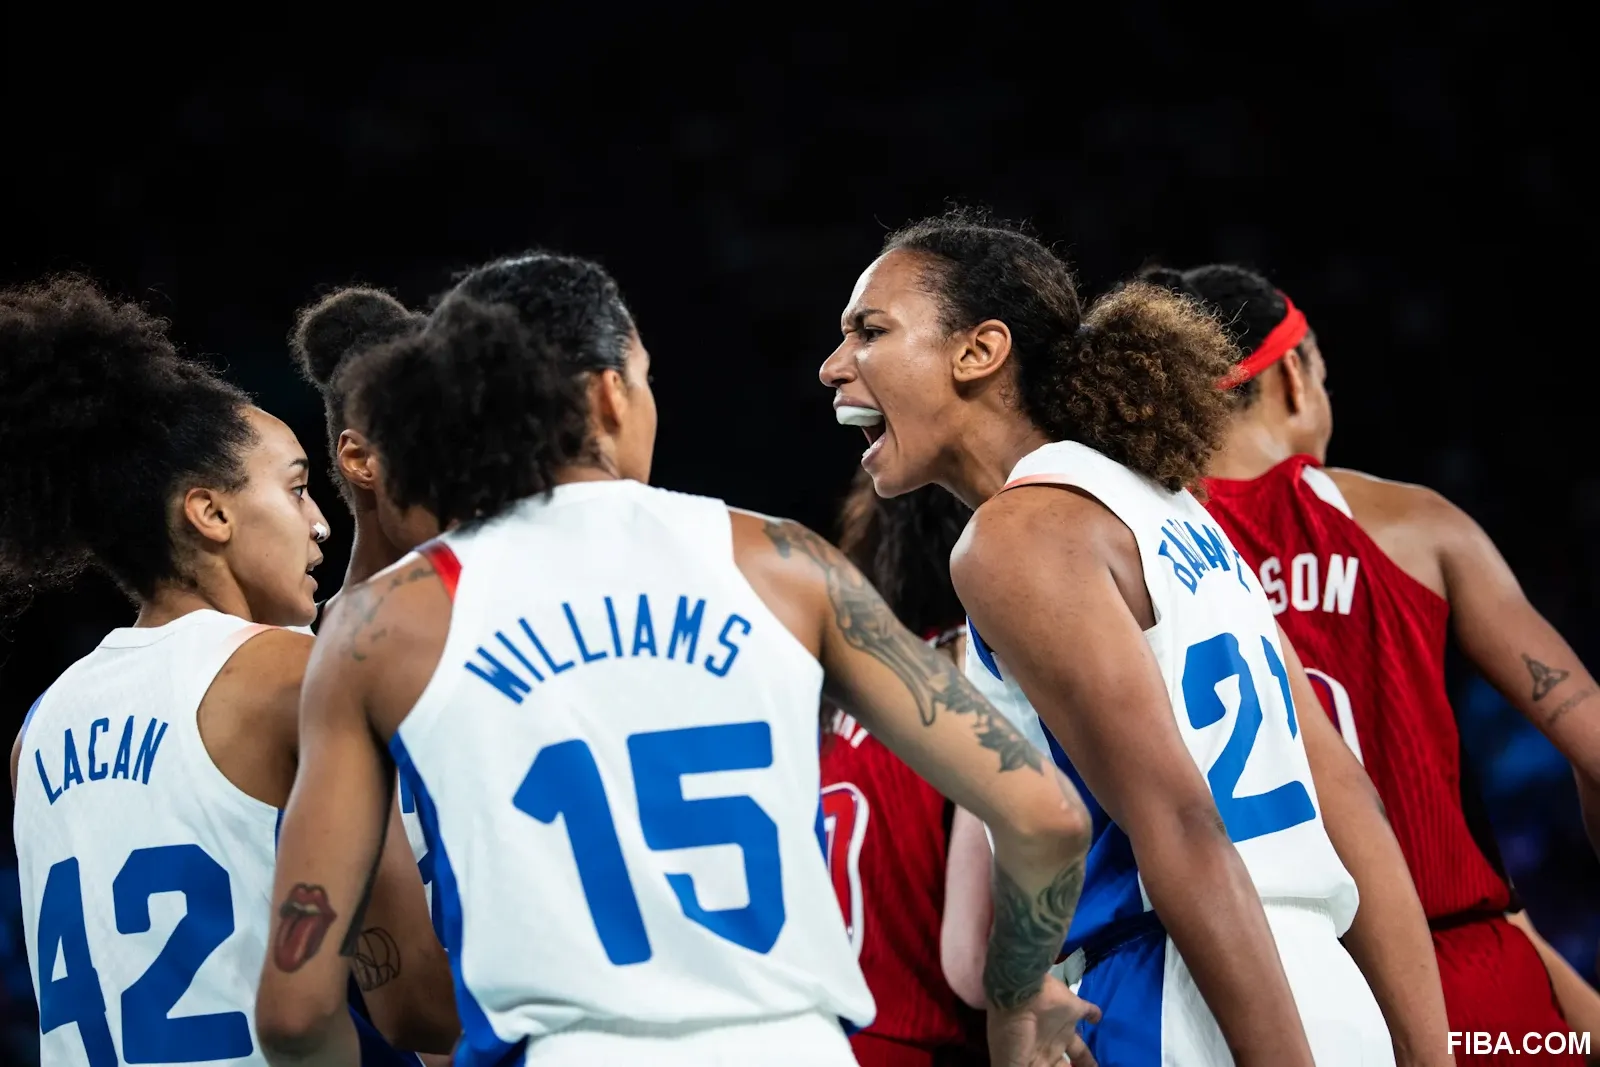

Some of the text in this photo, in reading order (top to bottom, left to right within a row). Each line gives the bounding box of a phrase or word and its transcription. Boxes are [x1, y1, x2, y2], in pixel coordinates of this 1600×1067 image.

[464, 594, 753, 705] WILLIAMS
[35, 715, 169, 806] LACAN
[512, 720, 787, 967] 15
[37, 843, 254, 1067] 42
